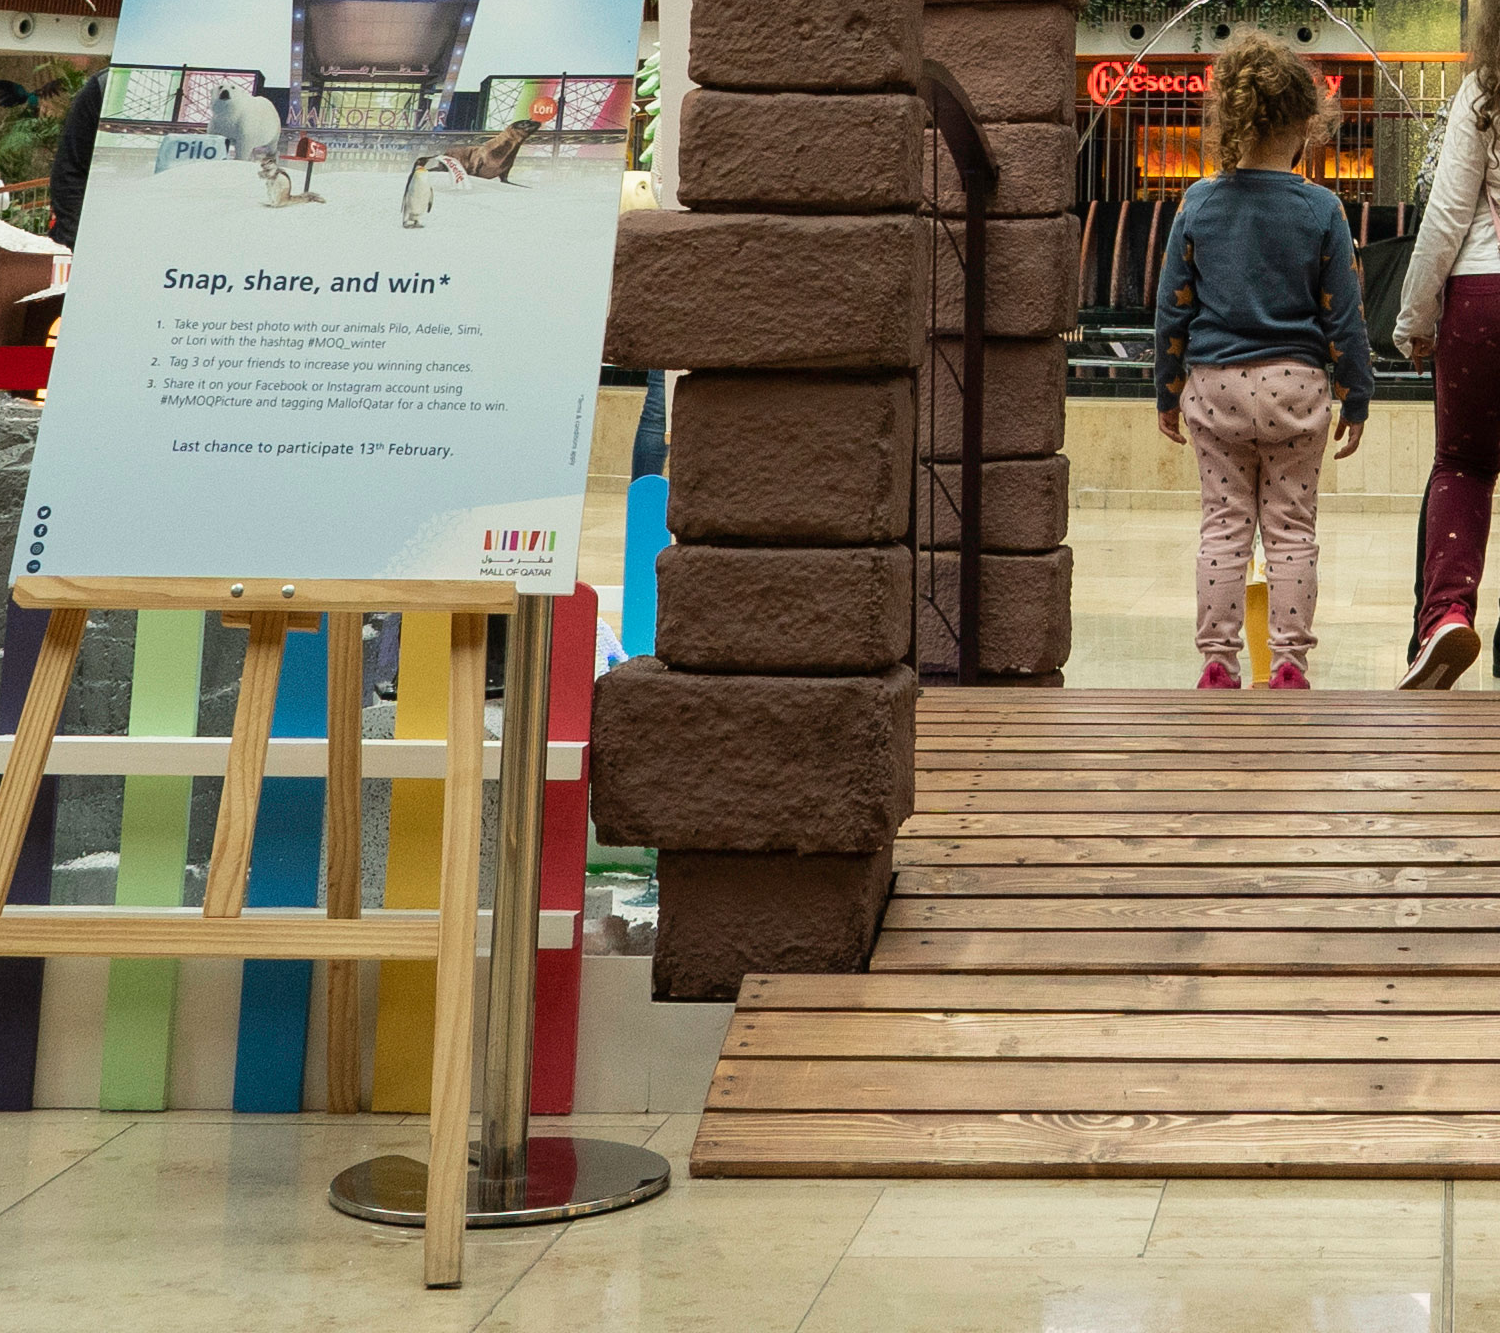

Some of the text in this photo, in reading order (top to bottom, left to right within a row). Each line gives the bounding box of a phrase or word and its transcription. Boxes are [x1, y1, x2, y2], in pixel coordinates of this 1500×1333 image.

[1087, 61, 1214, 106] Cheeseca
[533, 102, 554, 115] Lori
[346, 108, 375, 129] OF
[378, 108, 448, 131] QATAR
[176, 141, 217, 161] Pilo
[163, 268, 234, 296] Snap,
[243, 268, 321, 295] share,
[330, 271, 380, 293] and
[157, 318, 483, 337] 1. Take your best photo with our animals Pilo, Adelie, Simi,
[170, 335, 387, 351] or Lori with the hashtag #MOQ_winter
[150, 355, 473, 375] 2. Tag 3 of your friends to increase you winning chances.
[146, 377, 464, 397] 3. Share it on your Facebook or Instagram account using
[160, 394, 508, 412] #MyMOQPicture and tagging MallofQatar for a chance to win.
[172, 439, 454, 460] Last chance to participate 13th February.
[479, 567, 552, 578] MALL OF QATAR
